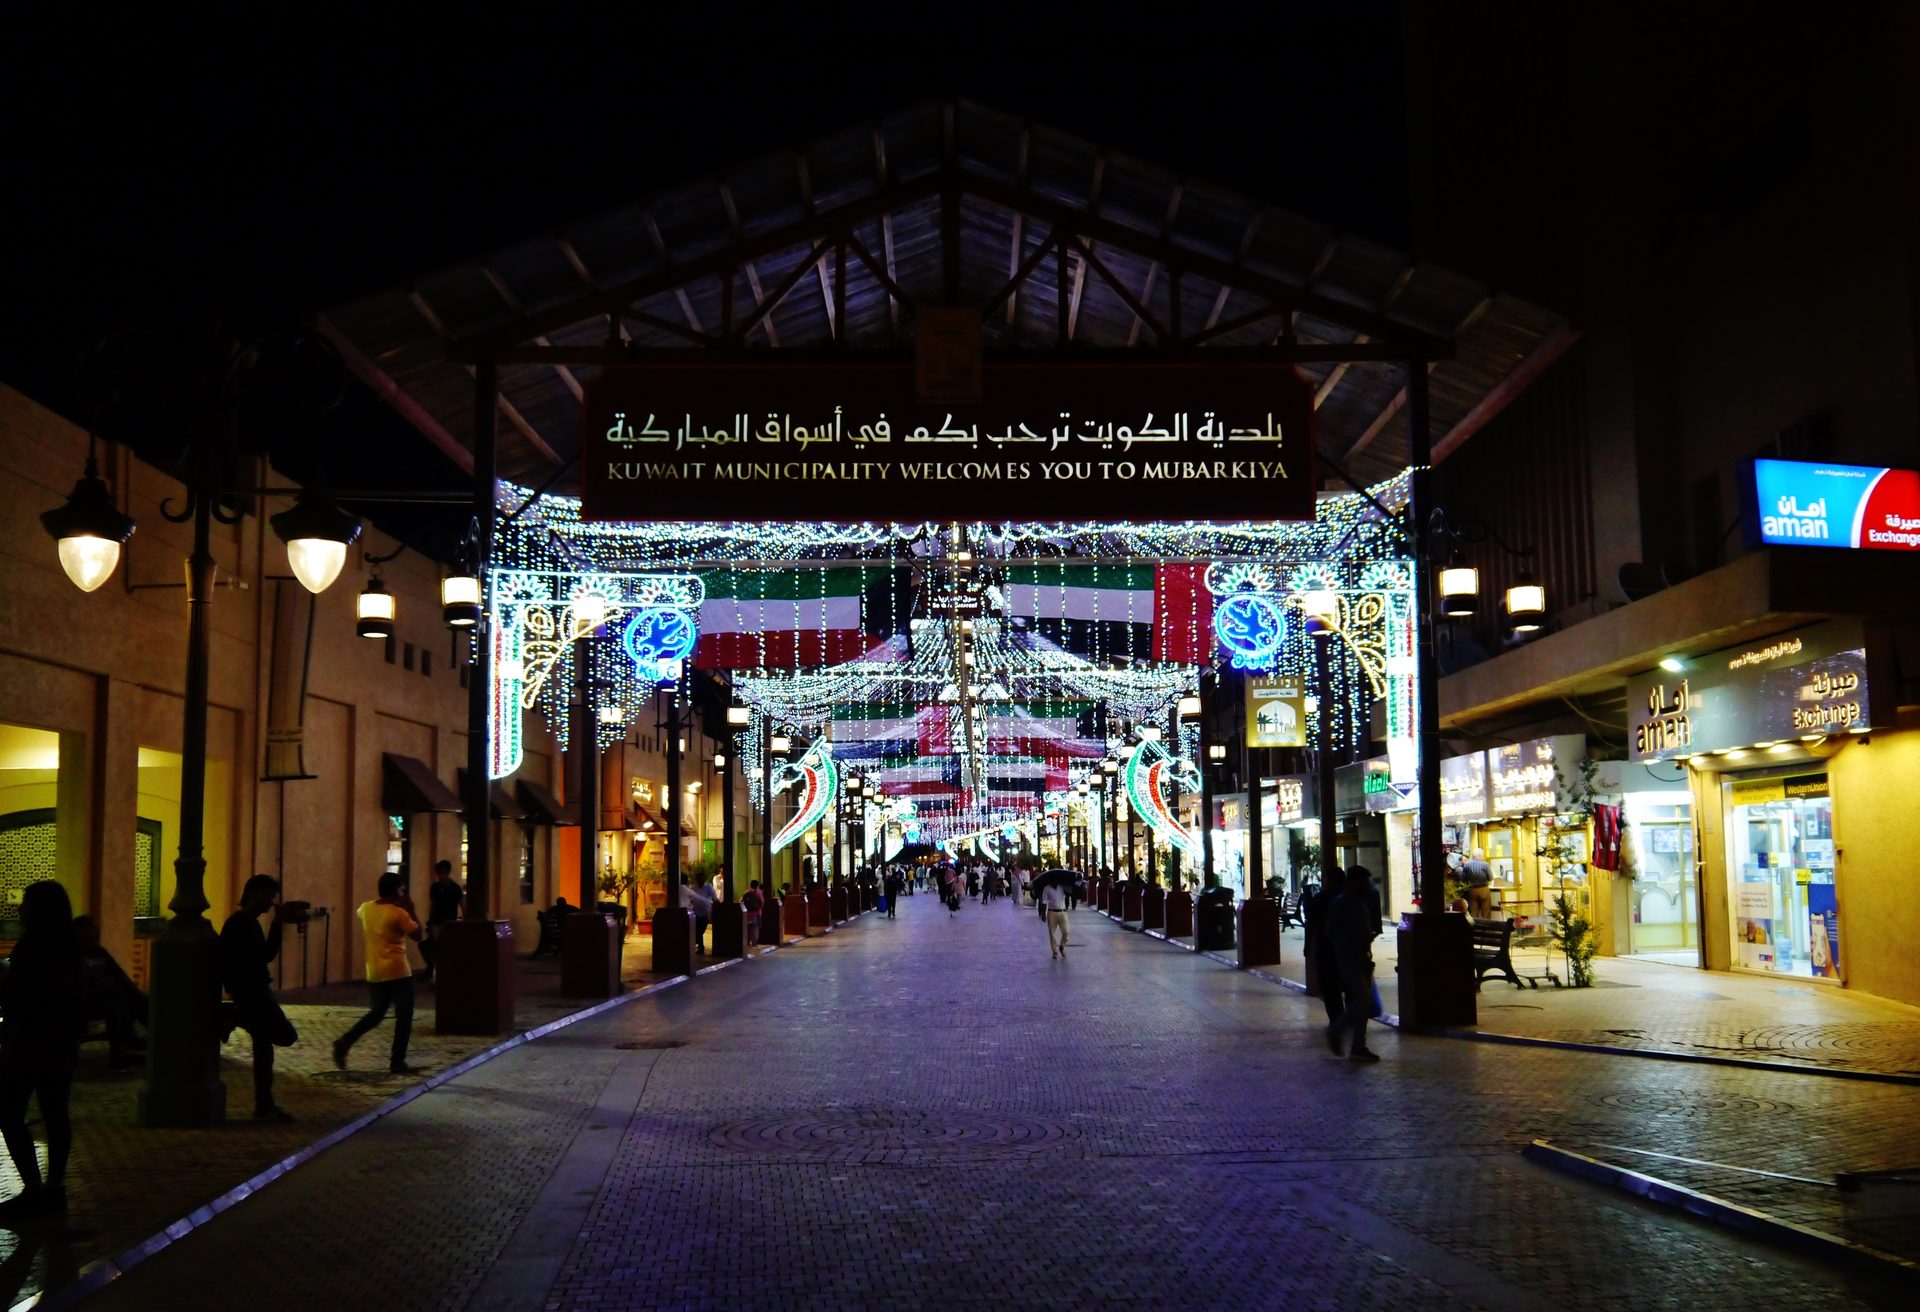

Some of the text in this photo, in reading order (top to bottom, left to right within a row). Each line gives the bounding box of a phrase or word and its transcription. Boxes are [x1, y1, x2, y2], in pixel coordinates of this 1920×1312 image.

[607, 406, 1283, 452] بلدية الكويت ترحب بكم في أسواق المباركية
[608, 461, 1288, 480] KUWAIT MUNICIPALITY WELCOMES YOU TO MUBARKIYA
[1763, 515, 1829, 539] aman
[1648, 678, 1690, 719] أمان
[1813, 672, 1859, 699] صيرفة
[1793, 702, 1860, 729] Exchange
[1636, 715, 1691, 755] aman
